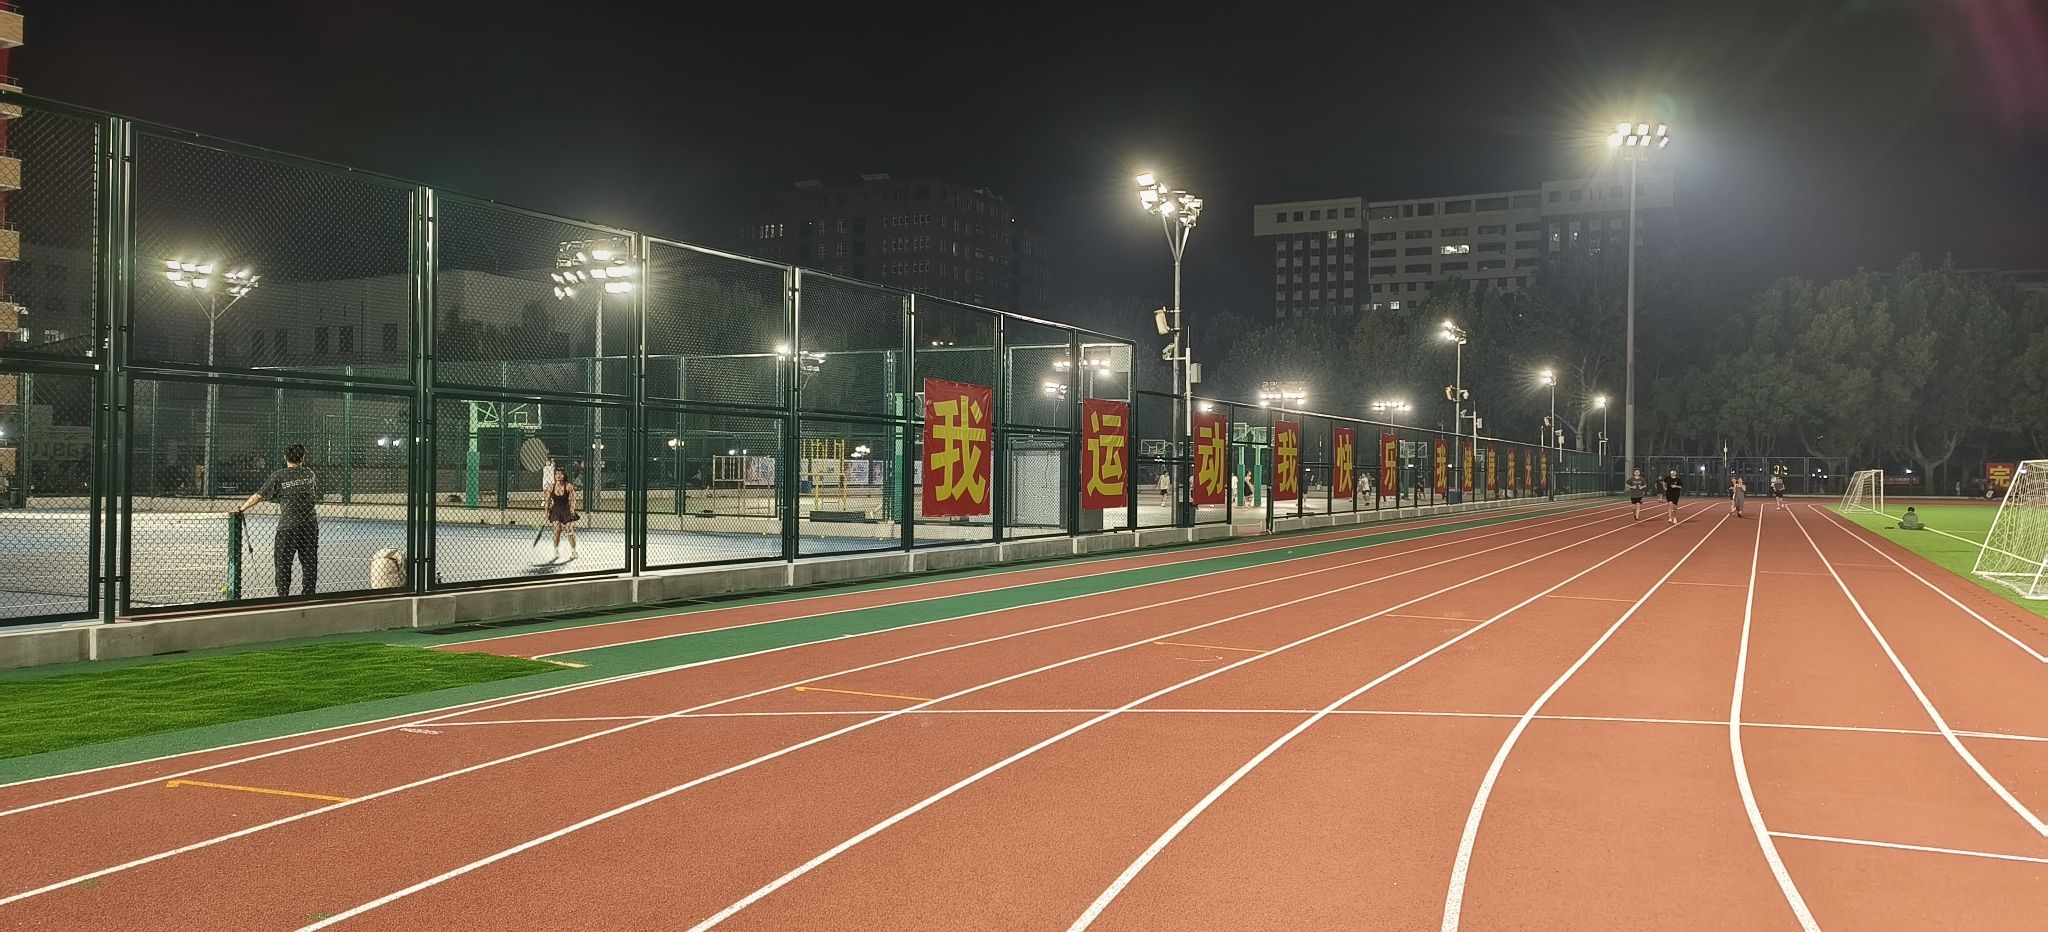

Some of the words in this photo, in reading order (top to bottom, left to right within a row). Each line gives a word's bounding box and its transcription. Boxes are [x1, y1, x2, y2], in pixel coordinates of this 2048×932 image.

[931, 396, 987, 504] 我
[1087, 411, 1125, 497] 运
[1198, 422, 1224, 496] 动
[1278, 430, 1298, 492] 我
[1337, 434, 1353, 492] 快
[1385, 442, 1397, 489] 乐
[1436, 444, 1447, 488] 我
[1990, 466, 2010, 487] 完
